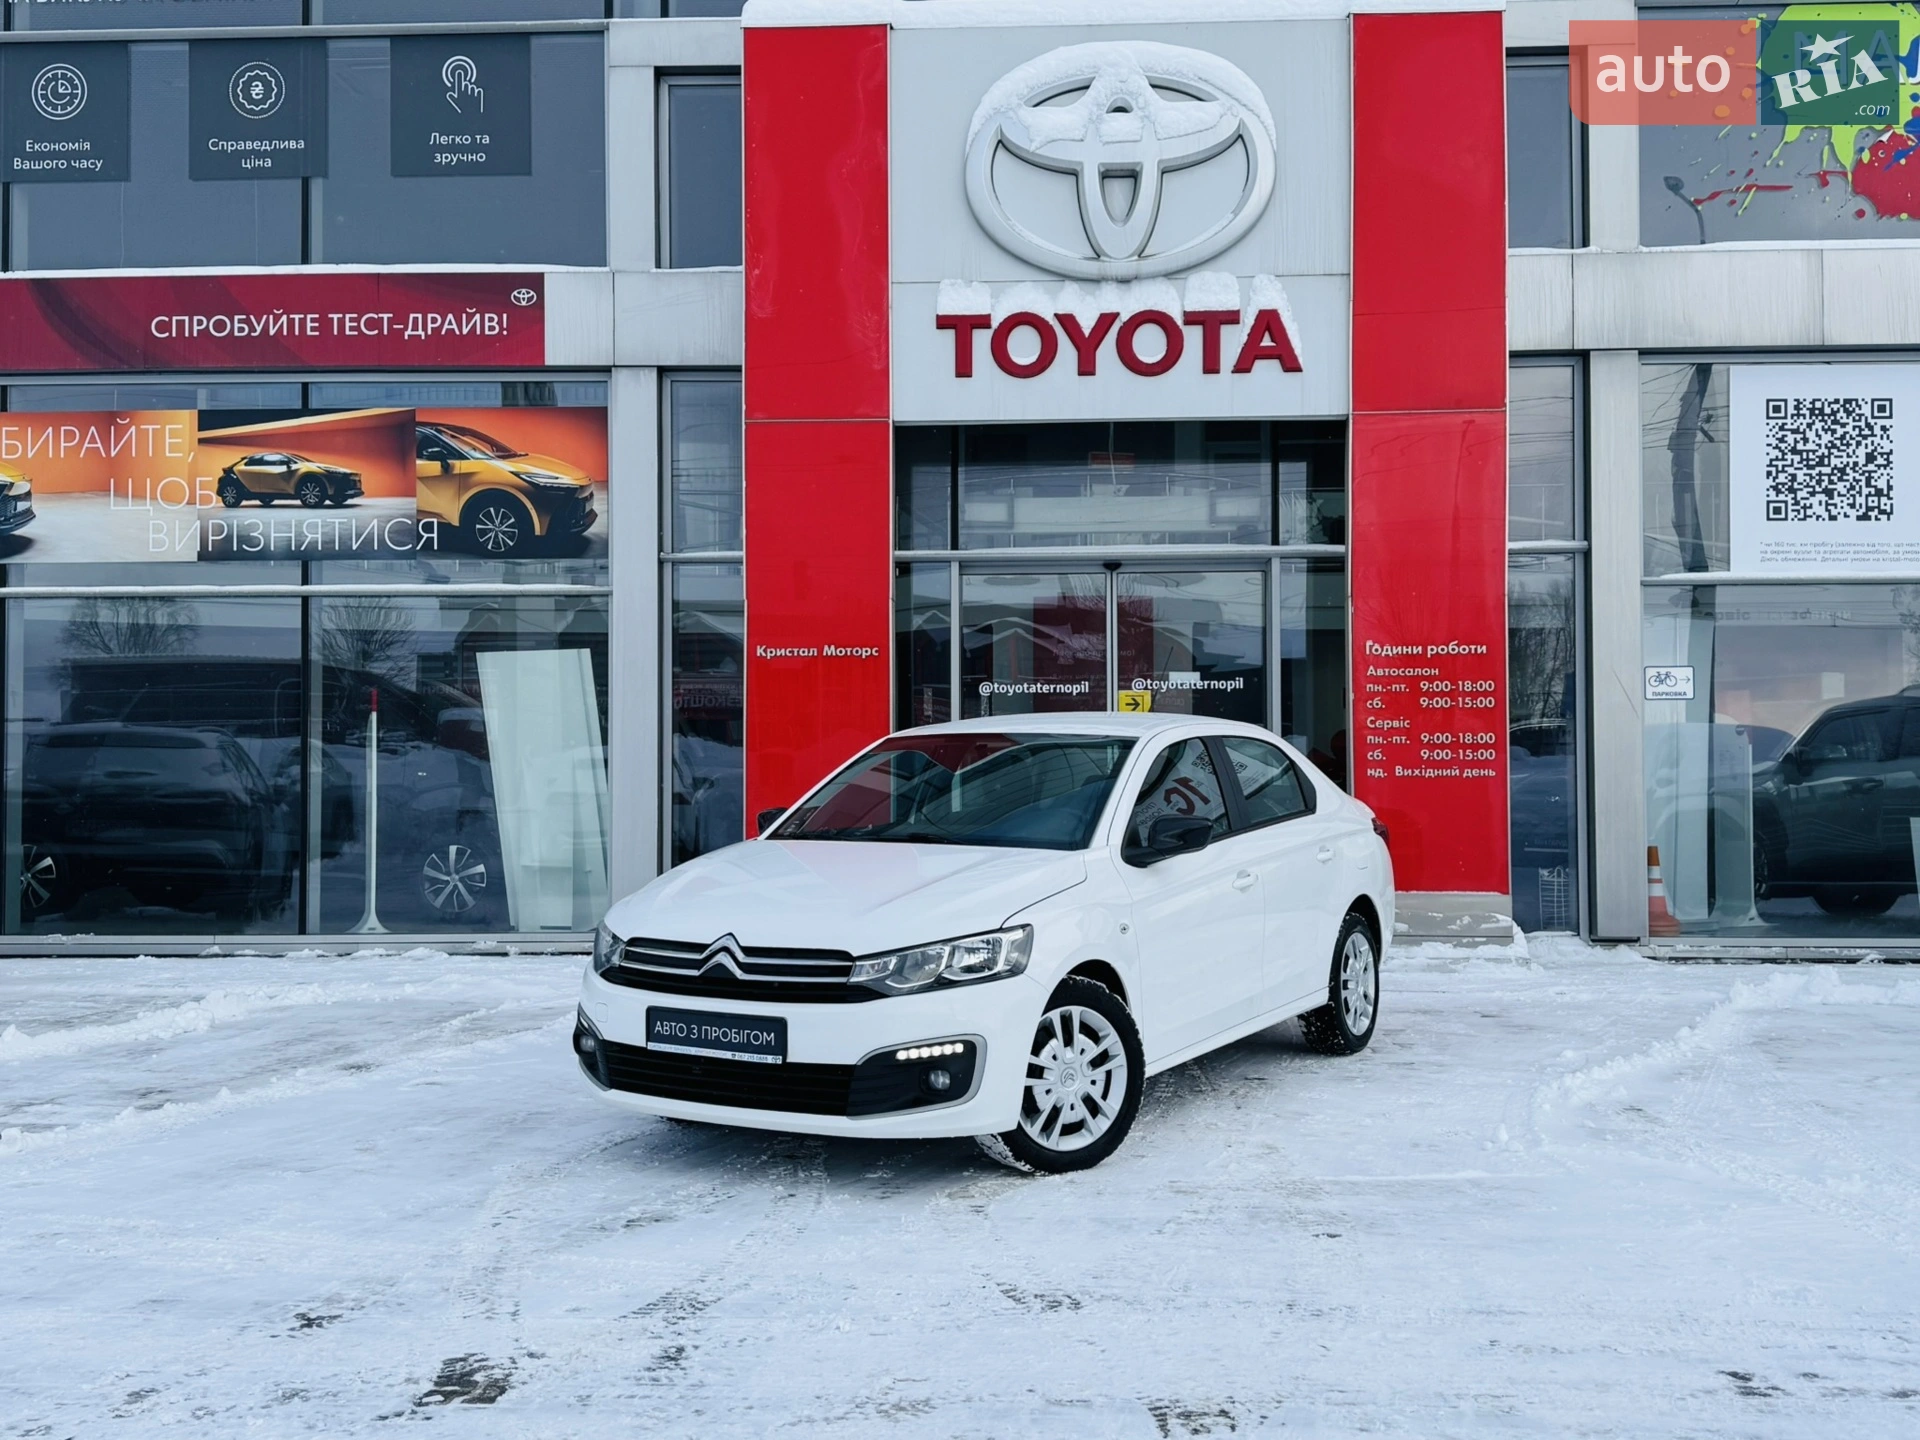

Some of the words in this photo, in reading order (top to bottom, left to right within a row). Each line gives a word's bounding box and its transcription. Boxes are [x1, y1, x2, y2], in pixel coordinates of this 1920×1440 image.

[25, 139, 91, 152] Економія
[208, 138, 305, 152] Справедлива
[429, 132, 471, 145] Легко
[475, 134, 490, 144] та
[13, 157, 67, 170] Вашого
[71, 158, 103, 172] часу
[241, 155, 272, 169] ціна
[433, 152, 486, 165] зручно
[150, 309, 320, 338] СПРОБУЙТЕ
[328, 307, 509, 340] ТЕСТ-ДРАЙВ!
[936, 309, 1303, 378] TOYOTA
[109, 478, 216, 516] ЩОБ
[148, 517, 440, 553] ВИРІЗНЯТИСЯ
[756, 645, 817, 659] Кристал
[823, 645, 879, 658] Моторс
[1365, 640, 1423, 657] Години
[1427, 640, 1487, 658] роботи
[1366, 665, 1439, 677] Автосалон
[978, 681, 1089, 695] @toyotaternopil
[1131, 677, 1244, 692] @toyotaternopil
[1366, 683, 1410, 692] пн.-пт.
[1420, 680, 1495, 692] 9:00-18:00
[1366, 696, 1386, 709] сб.
[1420, 697, 1495, 708] 9:00-15:00
[1366, 716, 1411, 730] Сервіс
[1366, 735, 1411, 744] пн.-пт.
[1420, 732, 1496, 744] 9:00-18:00
[1367, 748, 1387, 761] сб.
[1420, 749, 1496, 760] 9:00-15:00
[1367, 767, 1388, 778] нд.
[1395, 764, 1460, 778] Вихідний
[1463, 766, 1496, 777] день
[654, 1020, 687, 1037] АВТО
[690, 1024, 698, 1038] З
[702, 1026, 775, 1046] ПРОБІГОМ
